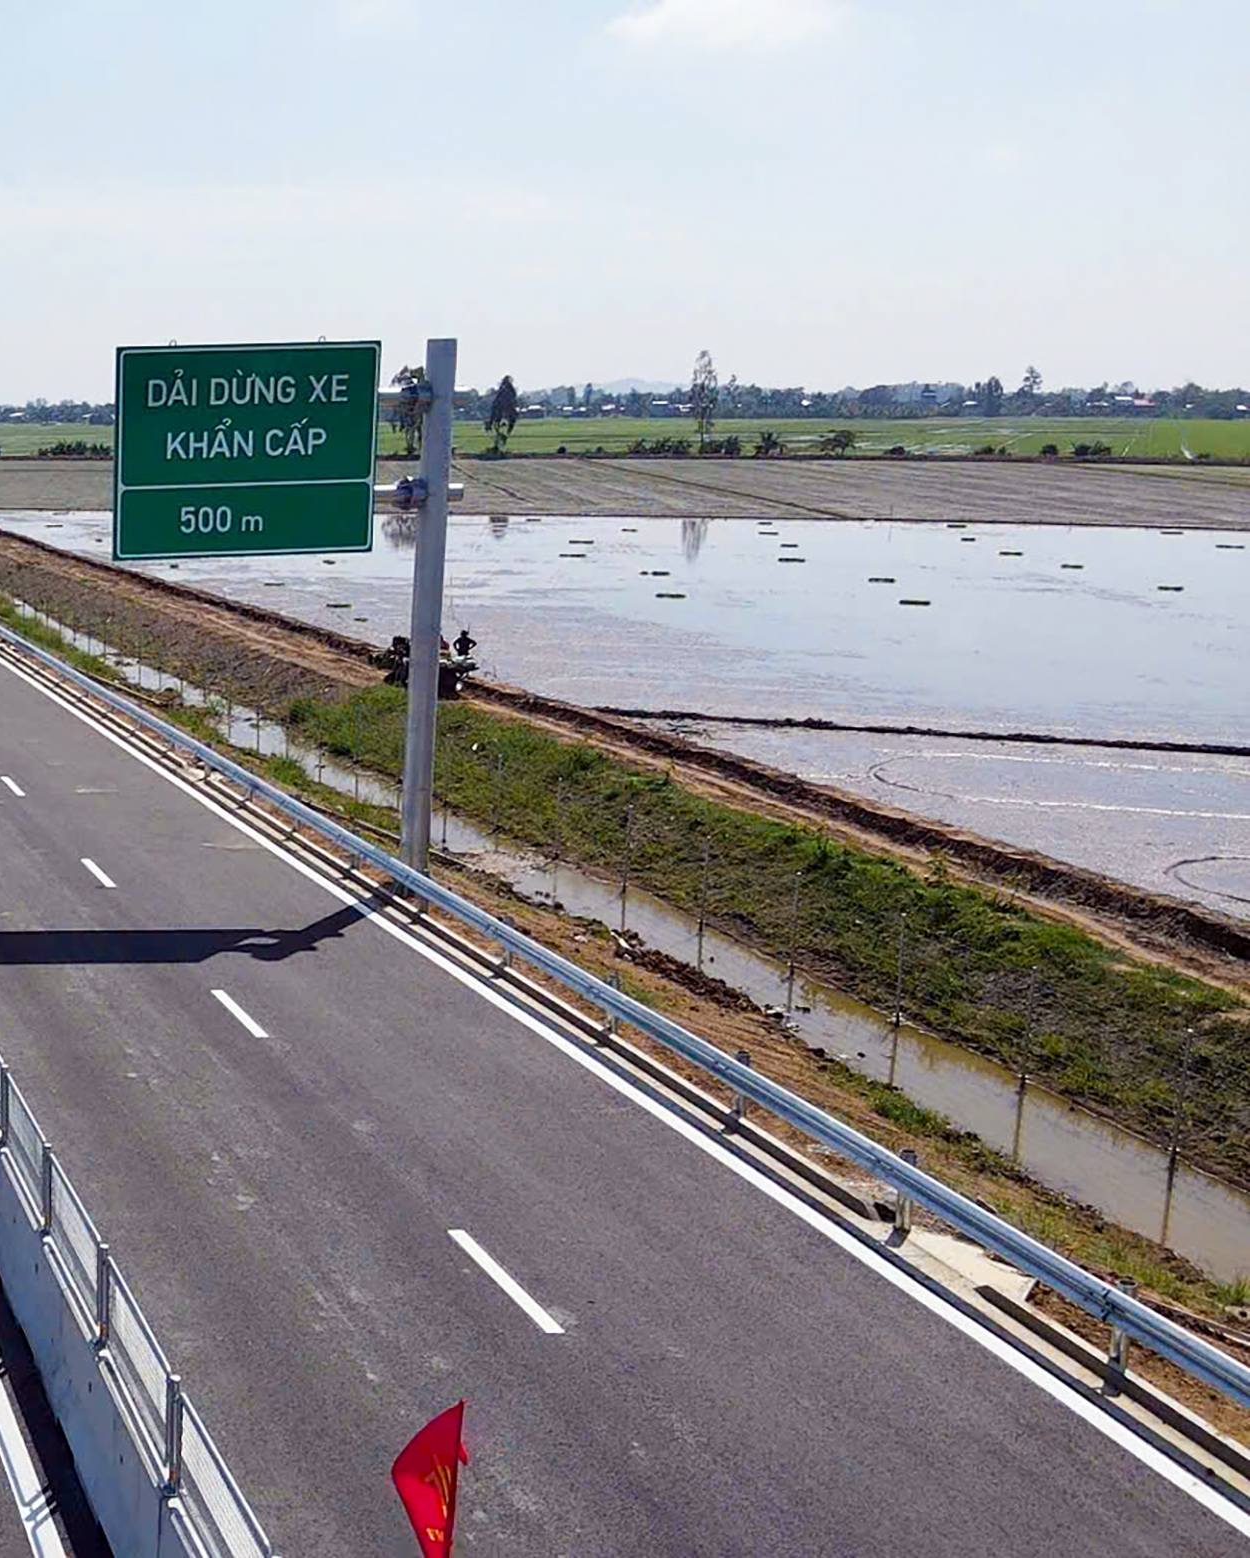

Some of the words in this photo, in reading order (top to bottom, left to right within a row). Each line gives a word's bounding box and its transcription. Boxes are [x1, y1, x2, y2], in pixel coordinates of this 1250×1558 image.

[147, 369, 198, 407] DẢI
[209, 369, 296, 406] DỪNG
[308, 374, 350, 403] XE
[166, 417, 254, 460] KHẨN
[265, 417, 327, 457] CẤP
[180, 506, 232, 533] 500
[241, 514, 263, 532] m
